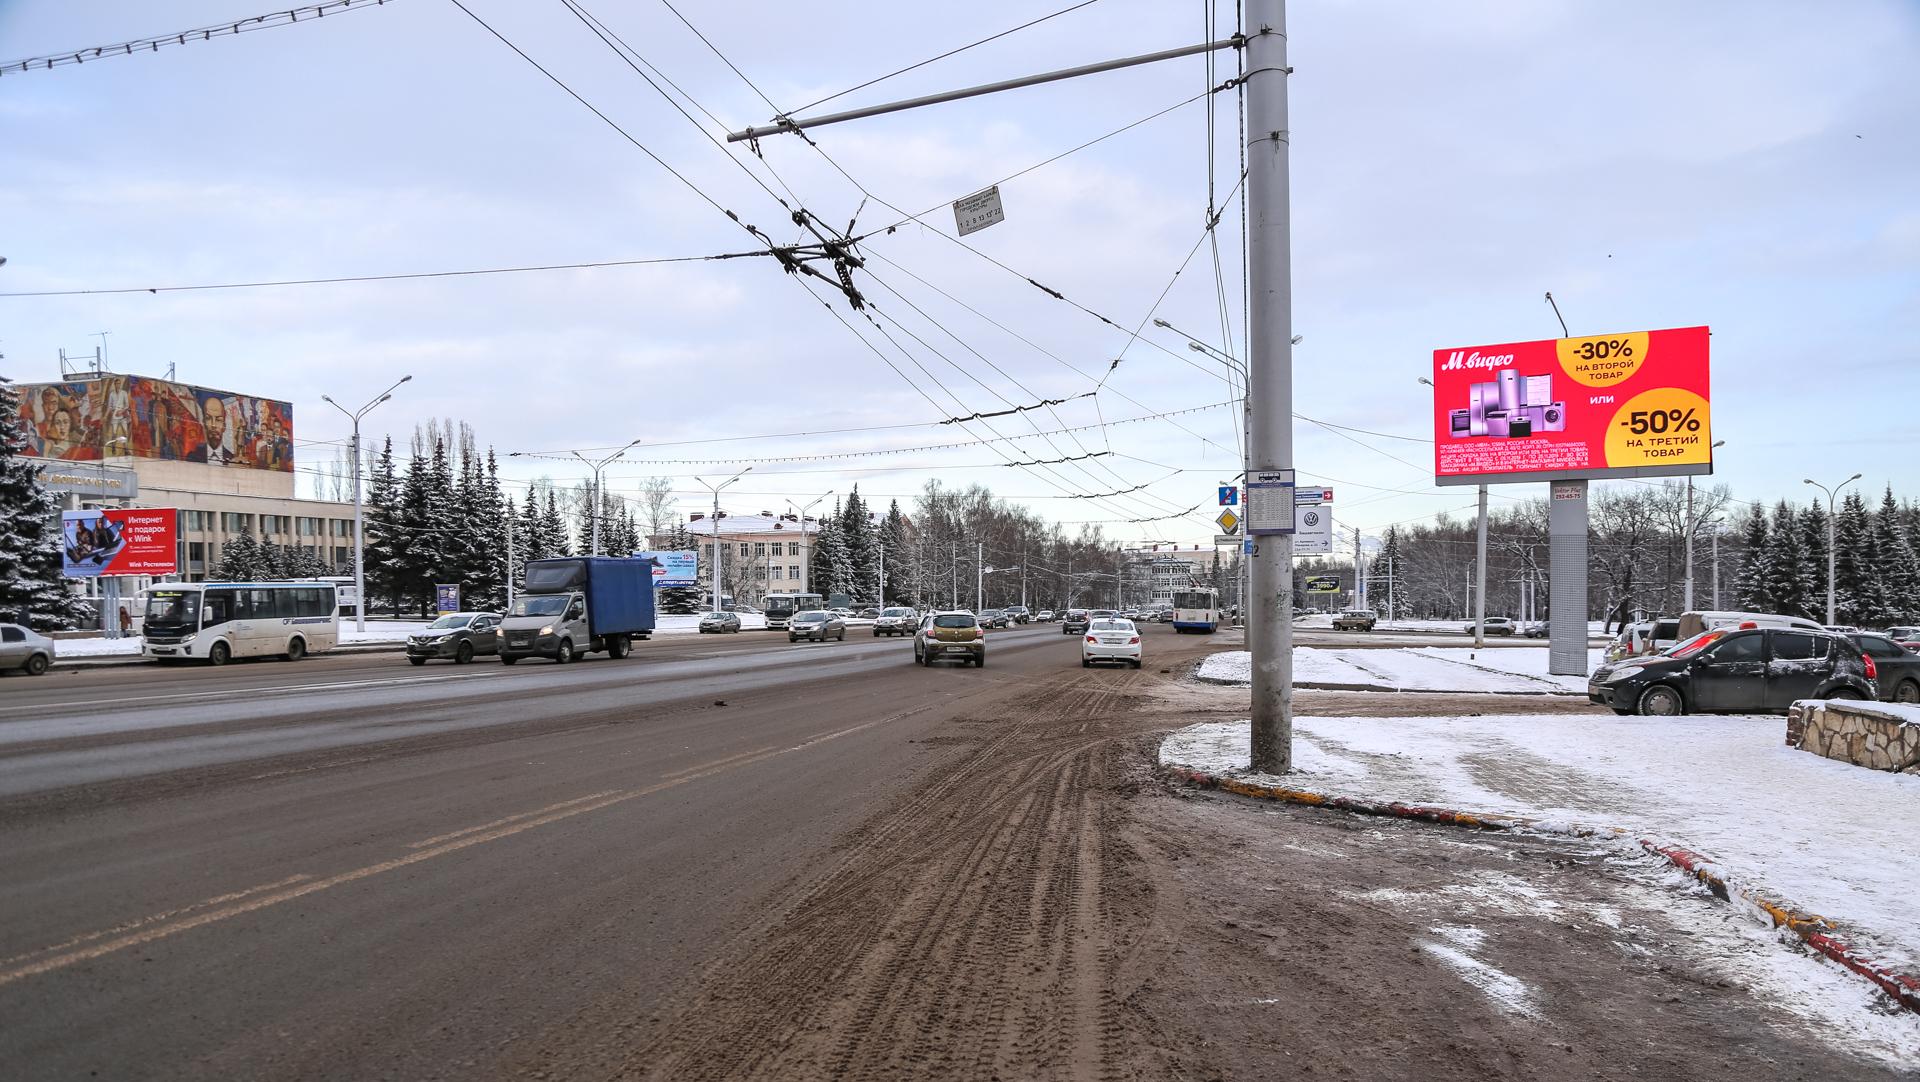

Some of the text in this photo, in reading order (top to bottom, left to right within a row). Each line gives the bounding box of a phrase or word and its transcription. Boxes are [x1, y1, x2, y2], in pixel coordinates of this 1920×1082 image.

[1574, 340, 1632, 360] -30%
[1441, 352, 1514, 370] М.видео
[1592, 360, 1634, 370] ВТОРОЙ
[1589, 371, 1623, 380] ТОВАР
[1621, 408, 1700, 434] -50%
[1627, 434, 1699, 447] НА ТРЕТИЙ
[1643, 448, 1684, 457] ТОВАР
